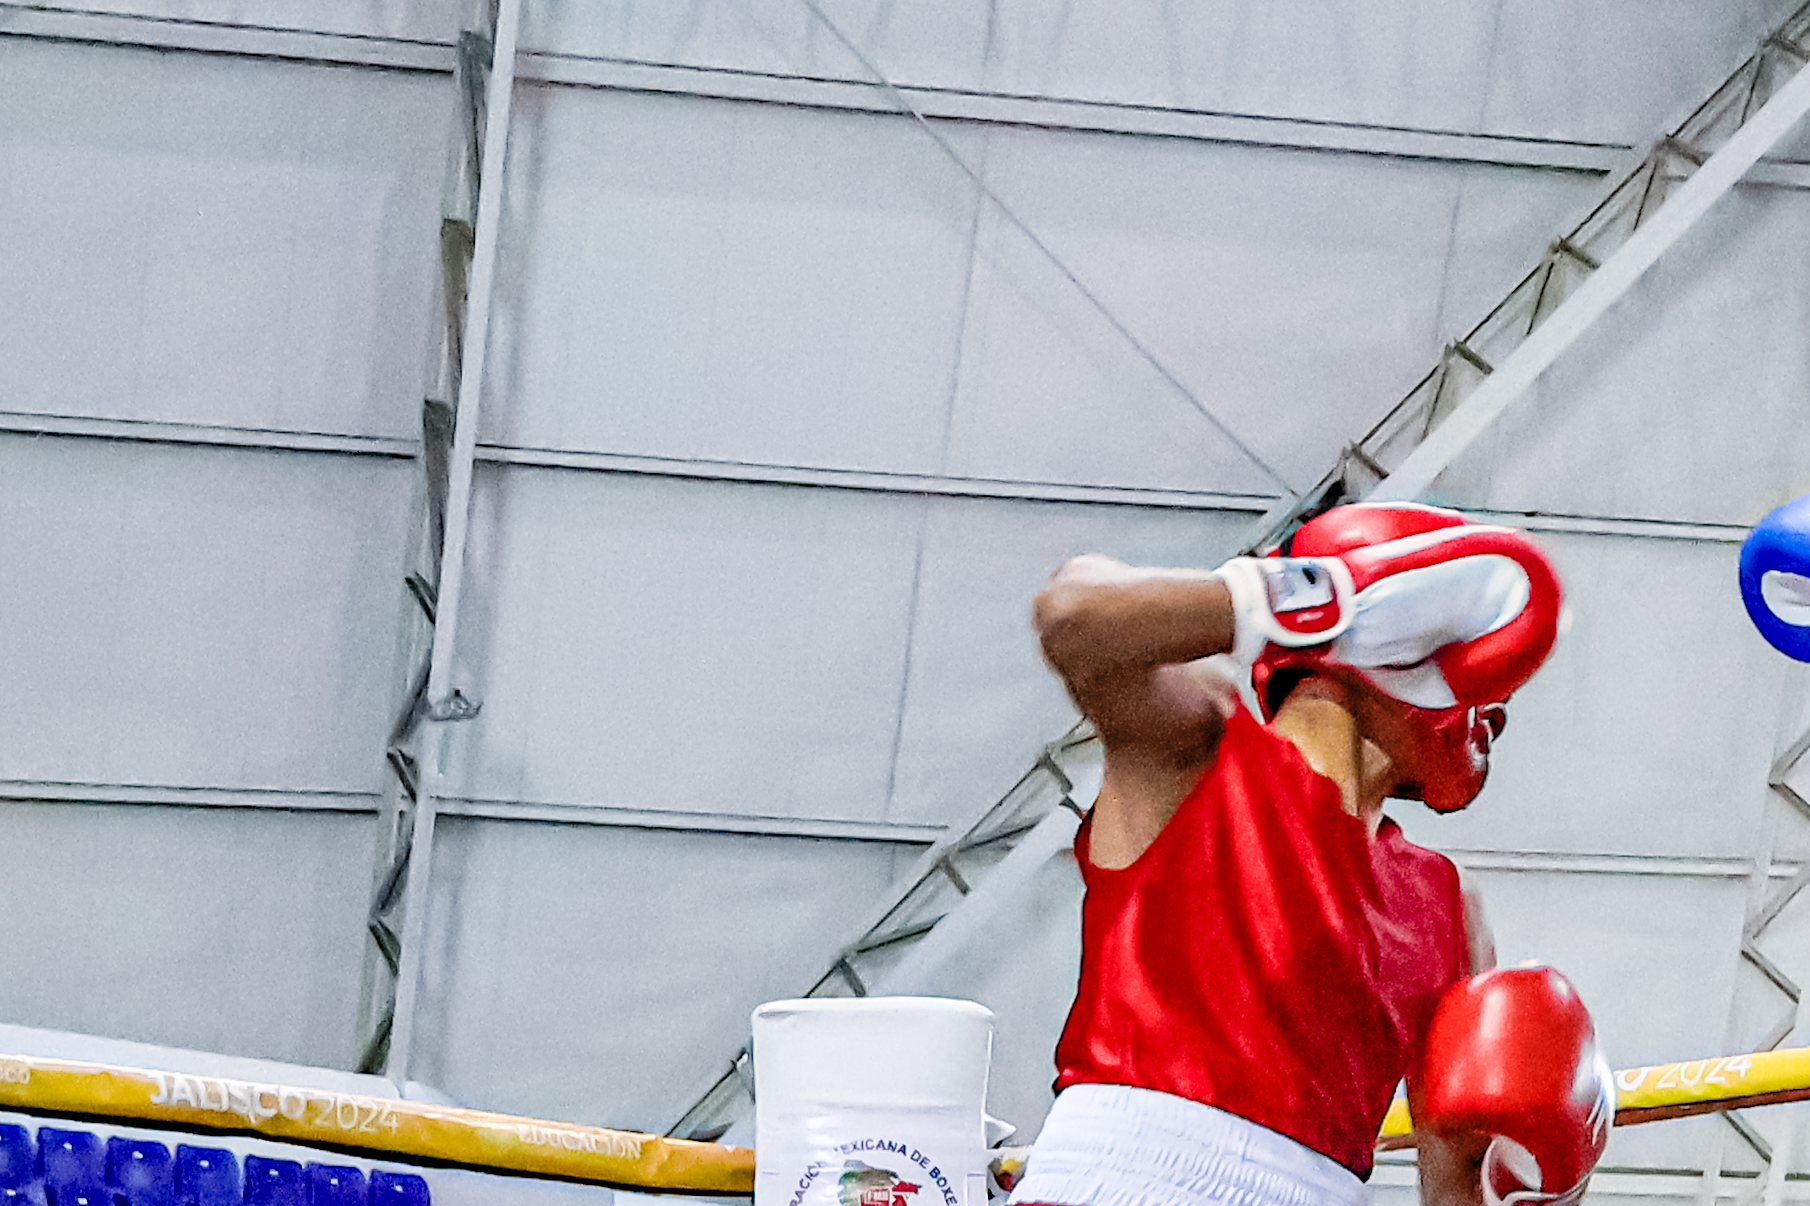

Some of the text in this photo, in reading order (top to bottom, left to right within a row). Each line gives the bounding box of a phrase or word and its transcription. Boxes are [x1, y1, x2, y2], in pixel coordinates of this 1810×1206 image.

[1655, 1055, 1752, 1089] 2024
[150, 1073, 400, 1133] JALISCO 2024
[833, 1138, 907, 1157] EXICANA
[910, 1149, 931, 1170] DE
